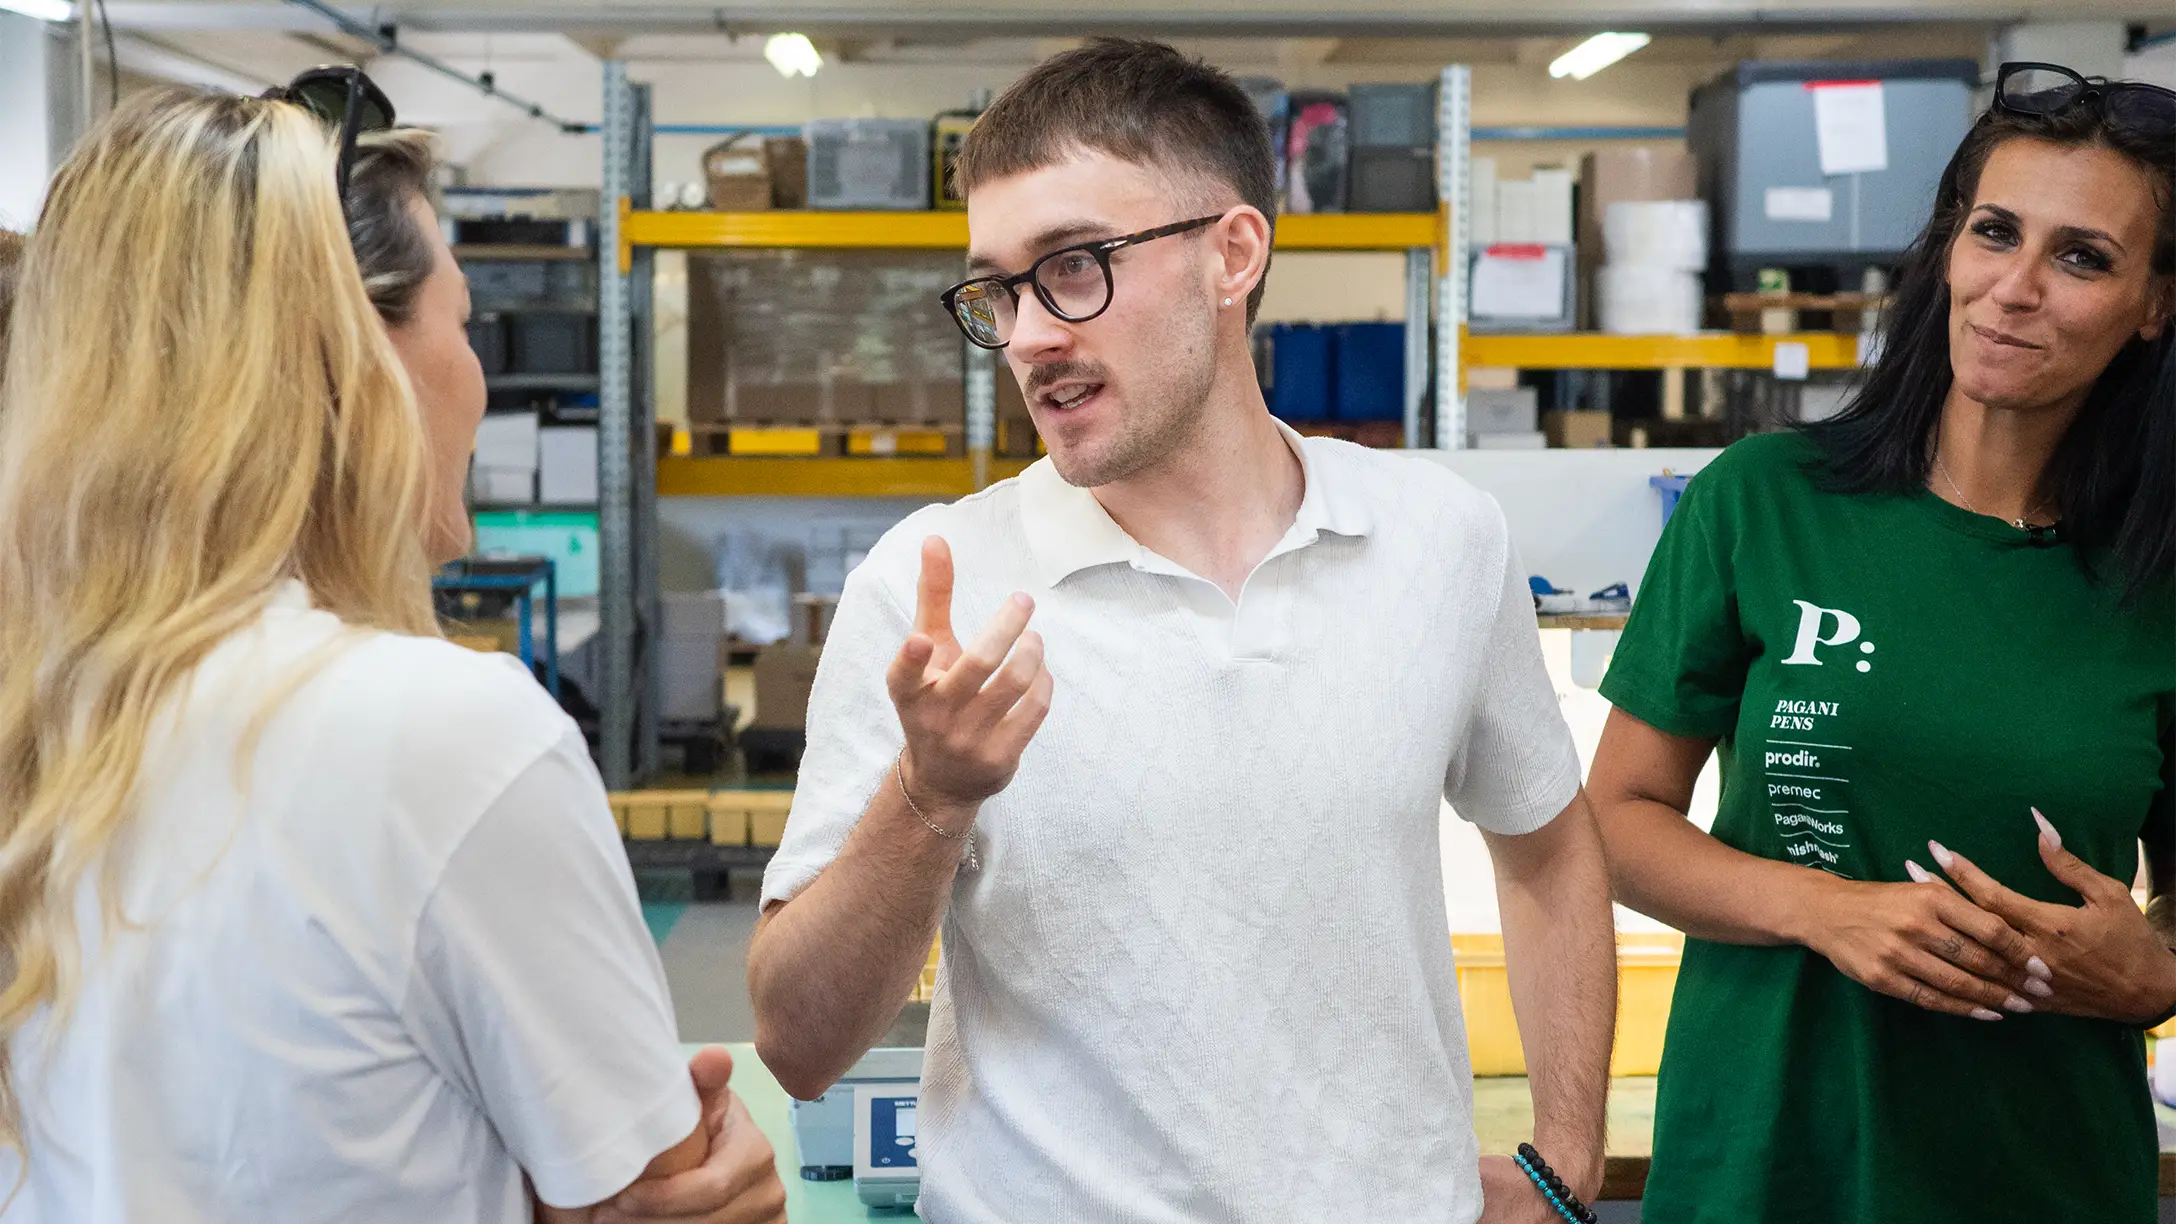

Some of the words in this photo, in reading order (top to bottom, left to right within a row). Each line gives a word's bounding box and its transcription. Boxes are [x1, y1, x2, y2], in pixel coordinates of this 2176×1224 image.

[1775, 700, 1840, 716] PAGANI
[1770, 715, 1814, 731] PENS
[1768, 784, 1821, 799] premec
